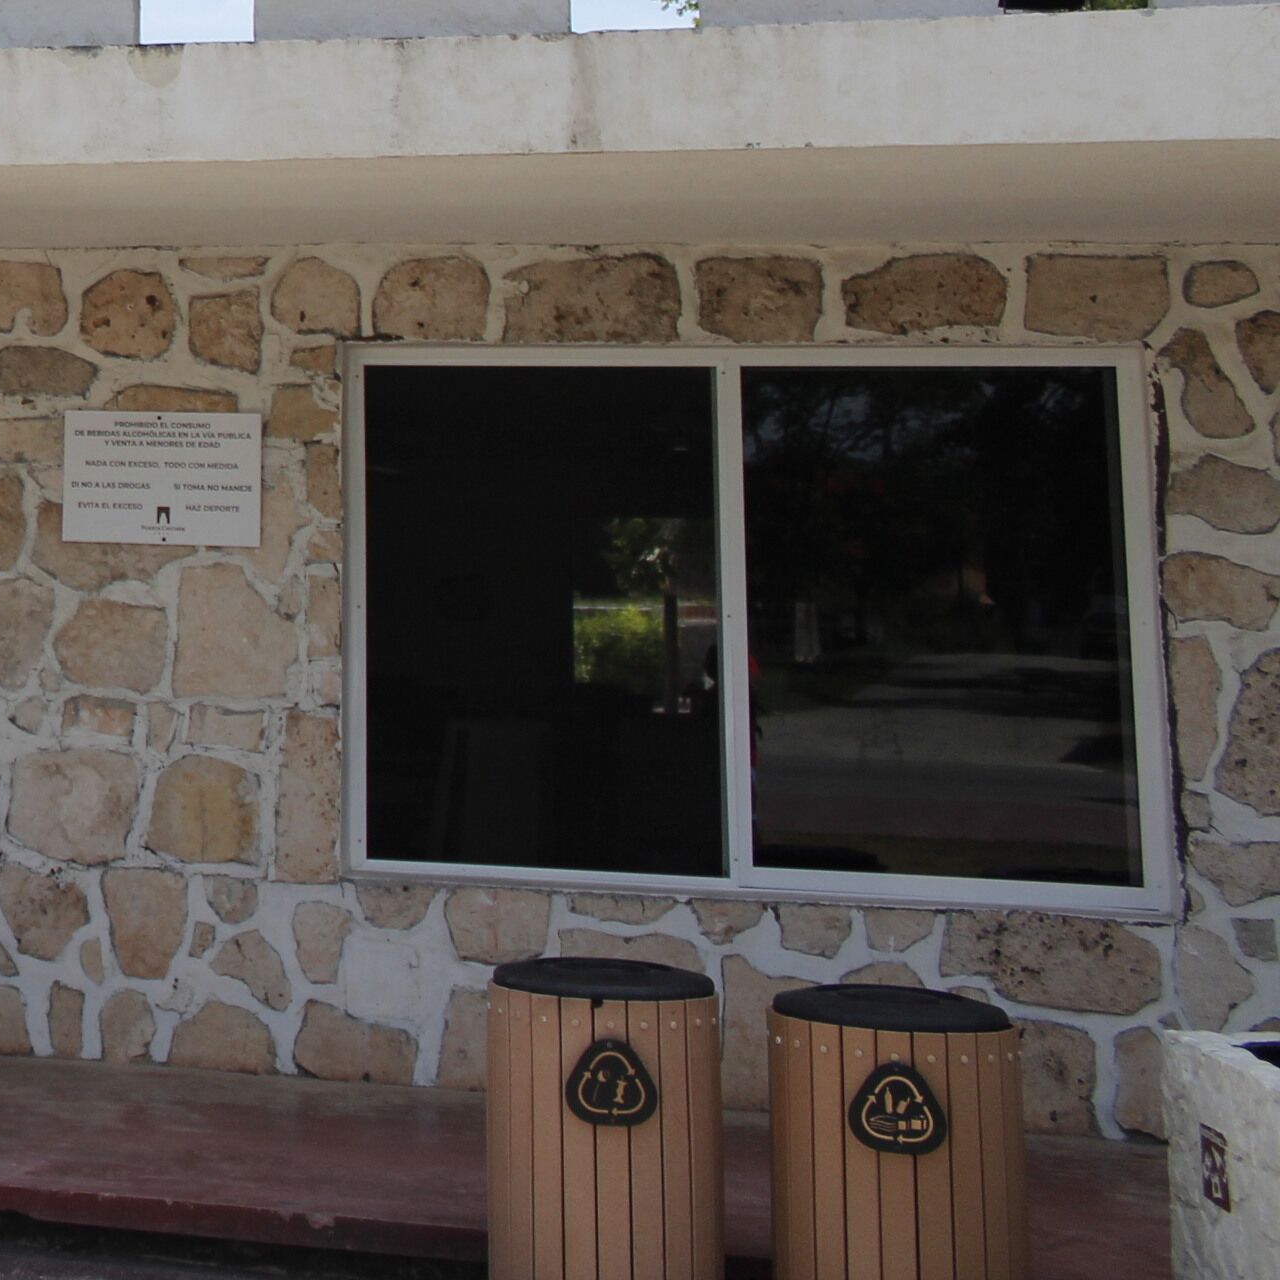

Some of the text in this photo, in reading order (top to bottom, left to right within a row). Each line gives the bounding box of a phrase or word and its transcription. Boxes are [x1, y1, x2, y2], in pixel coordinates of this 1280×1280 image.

[114, 421, 158, 429] PROHIBIDO
[170, 422, 210, 430] CONSUMO
[198, 441, 221, 449] EDAD
[164, 461, 186, 469] TODO
[207, 462, 239, 470] MEDIDA
